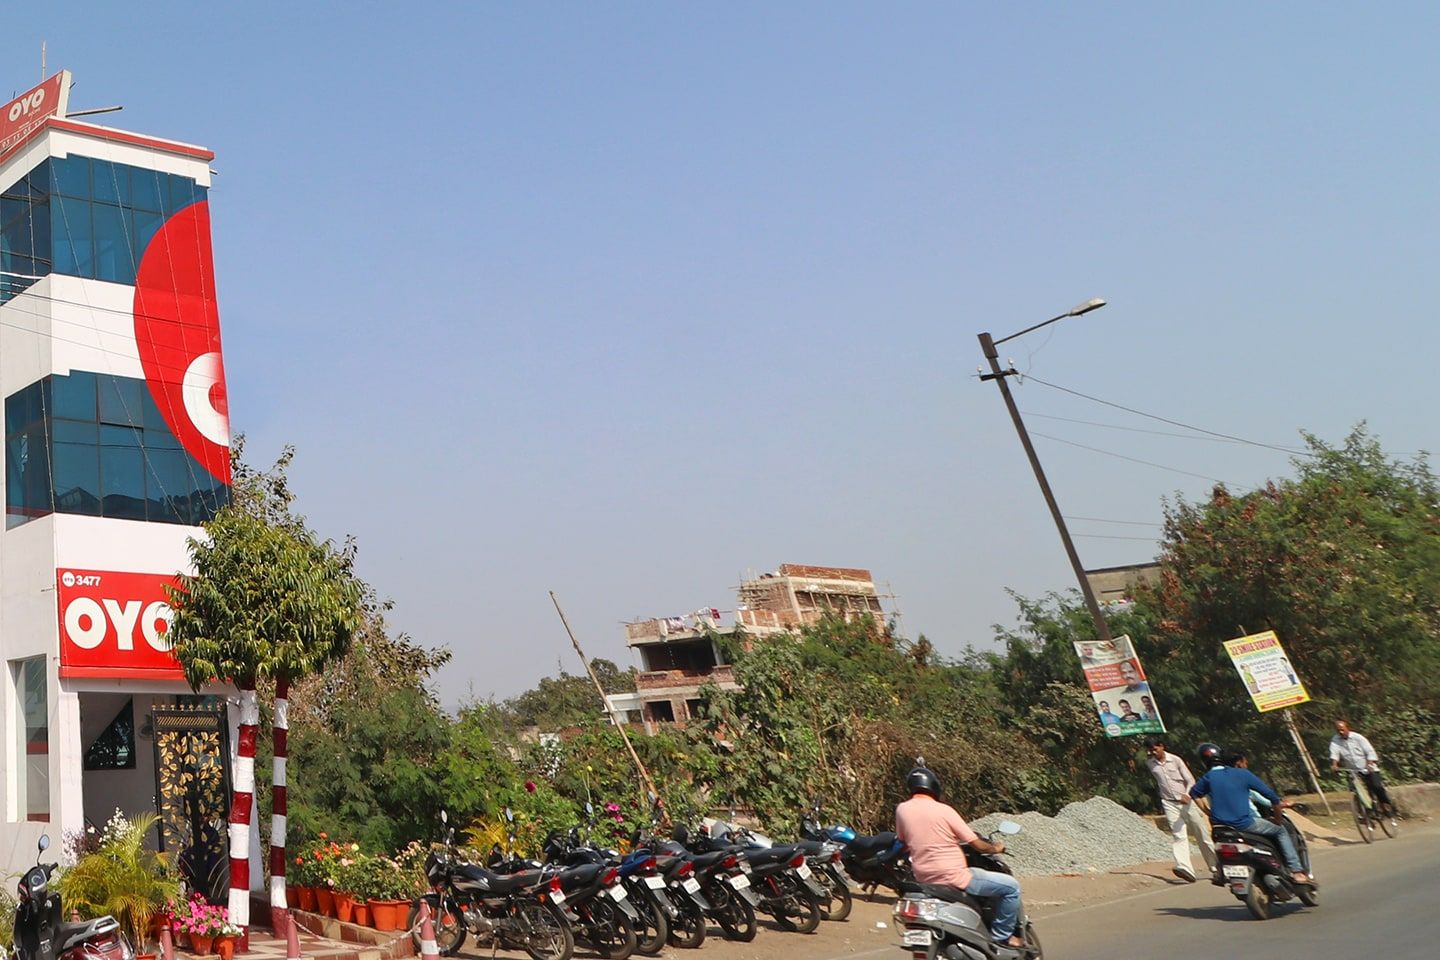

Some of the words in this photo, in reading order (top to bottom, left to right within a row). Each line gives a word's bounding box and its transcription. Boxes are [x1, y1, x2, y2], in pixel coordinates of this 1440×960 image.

[9, 88, 45, 122] OYO
[75, 576, 101, 586] 3477
[64, 597, 176, 652] OYO
